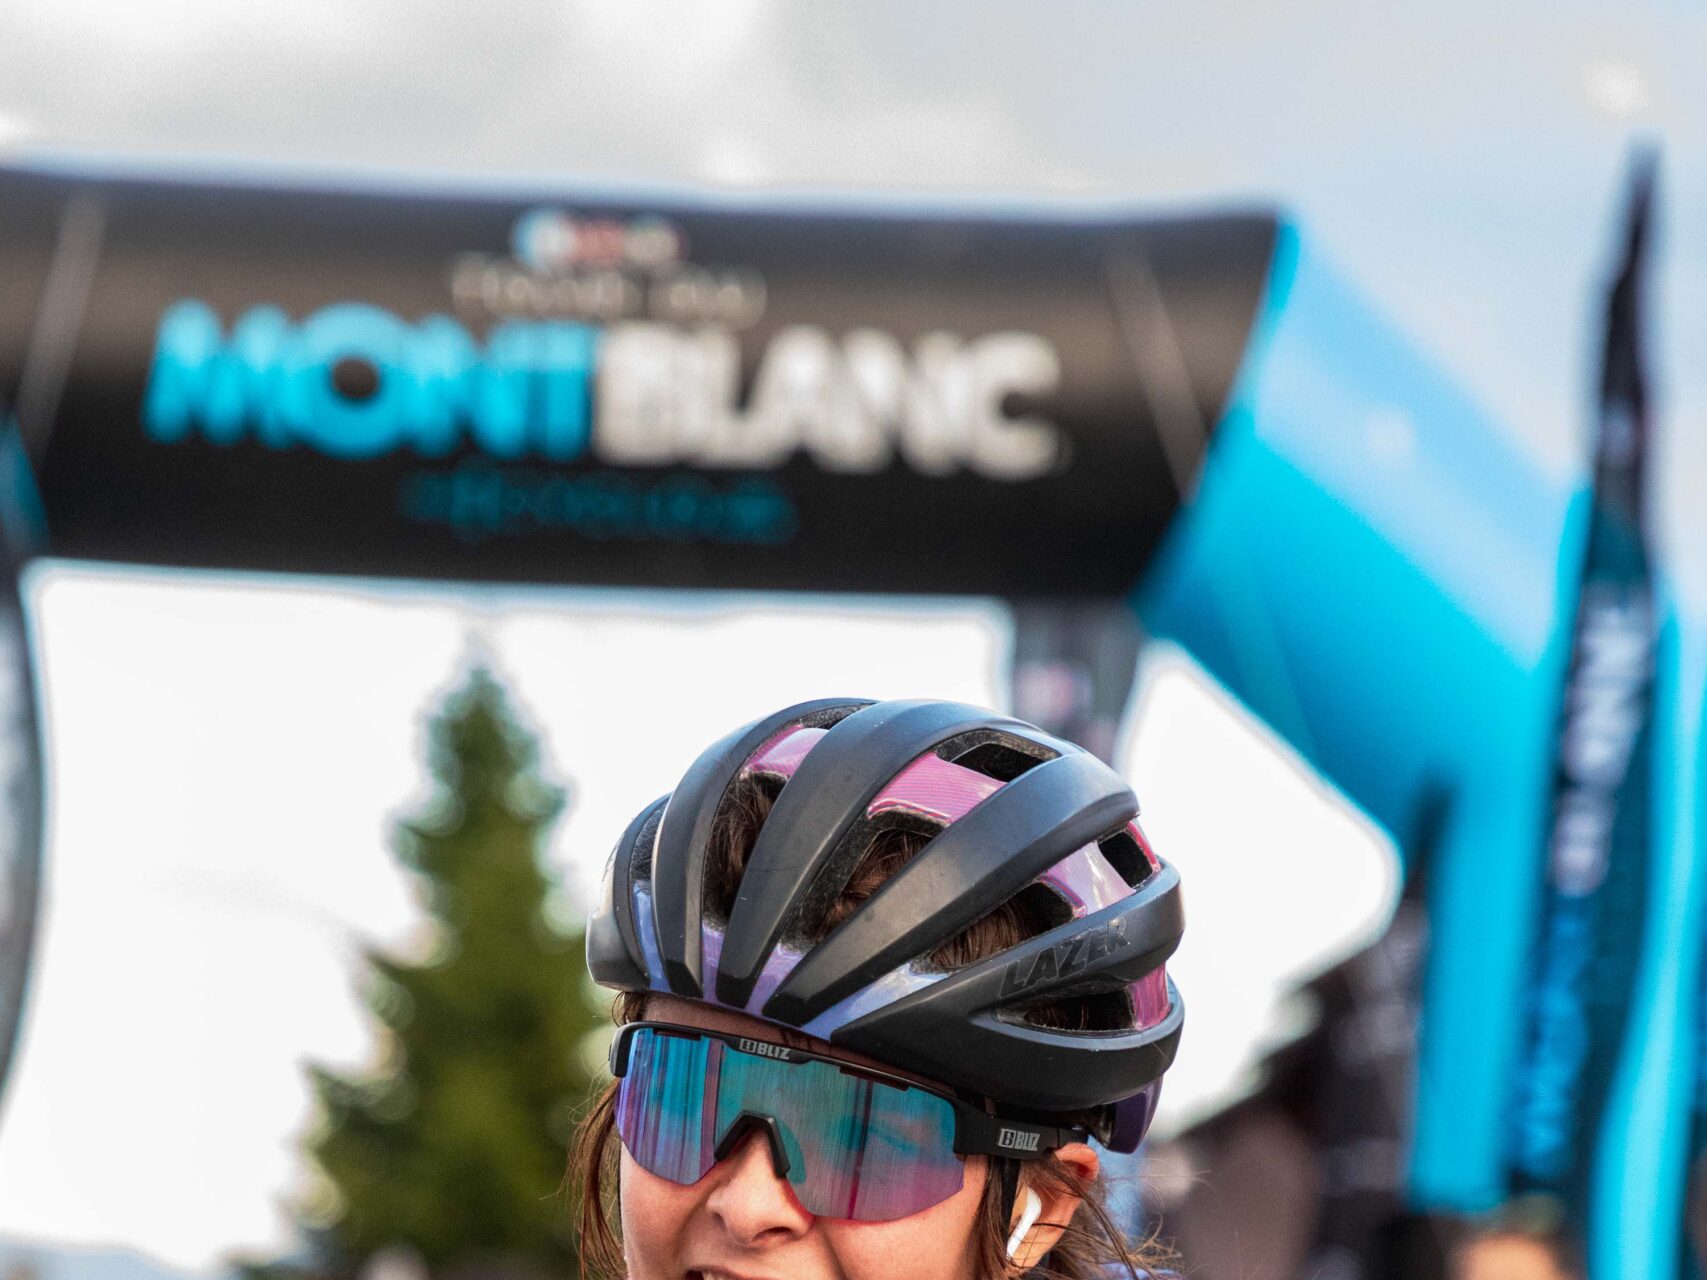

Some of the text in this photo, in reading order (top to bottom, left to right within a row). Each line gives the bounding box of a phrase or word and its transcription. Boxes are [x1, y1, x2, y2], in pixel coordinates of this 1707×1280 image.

[145, 297, 1064, 480] MONT BLANC
[999, 916, 1132, 999] LAZER
[756, 1041, 792, 1060] BLIZ
[1013, 1130, 1041, 1152] BLIZ
